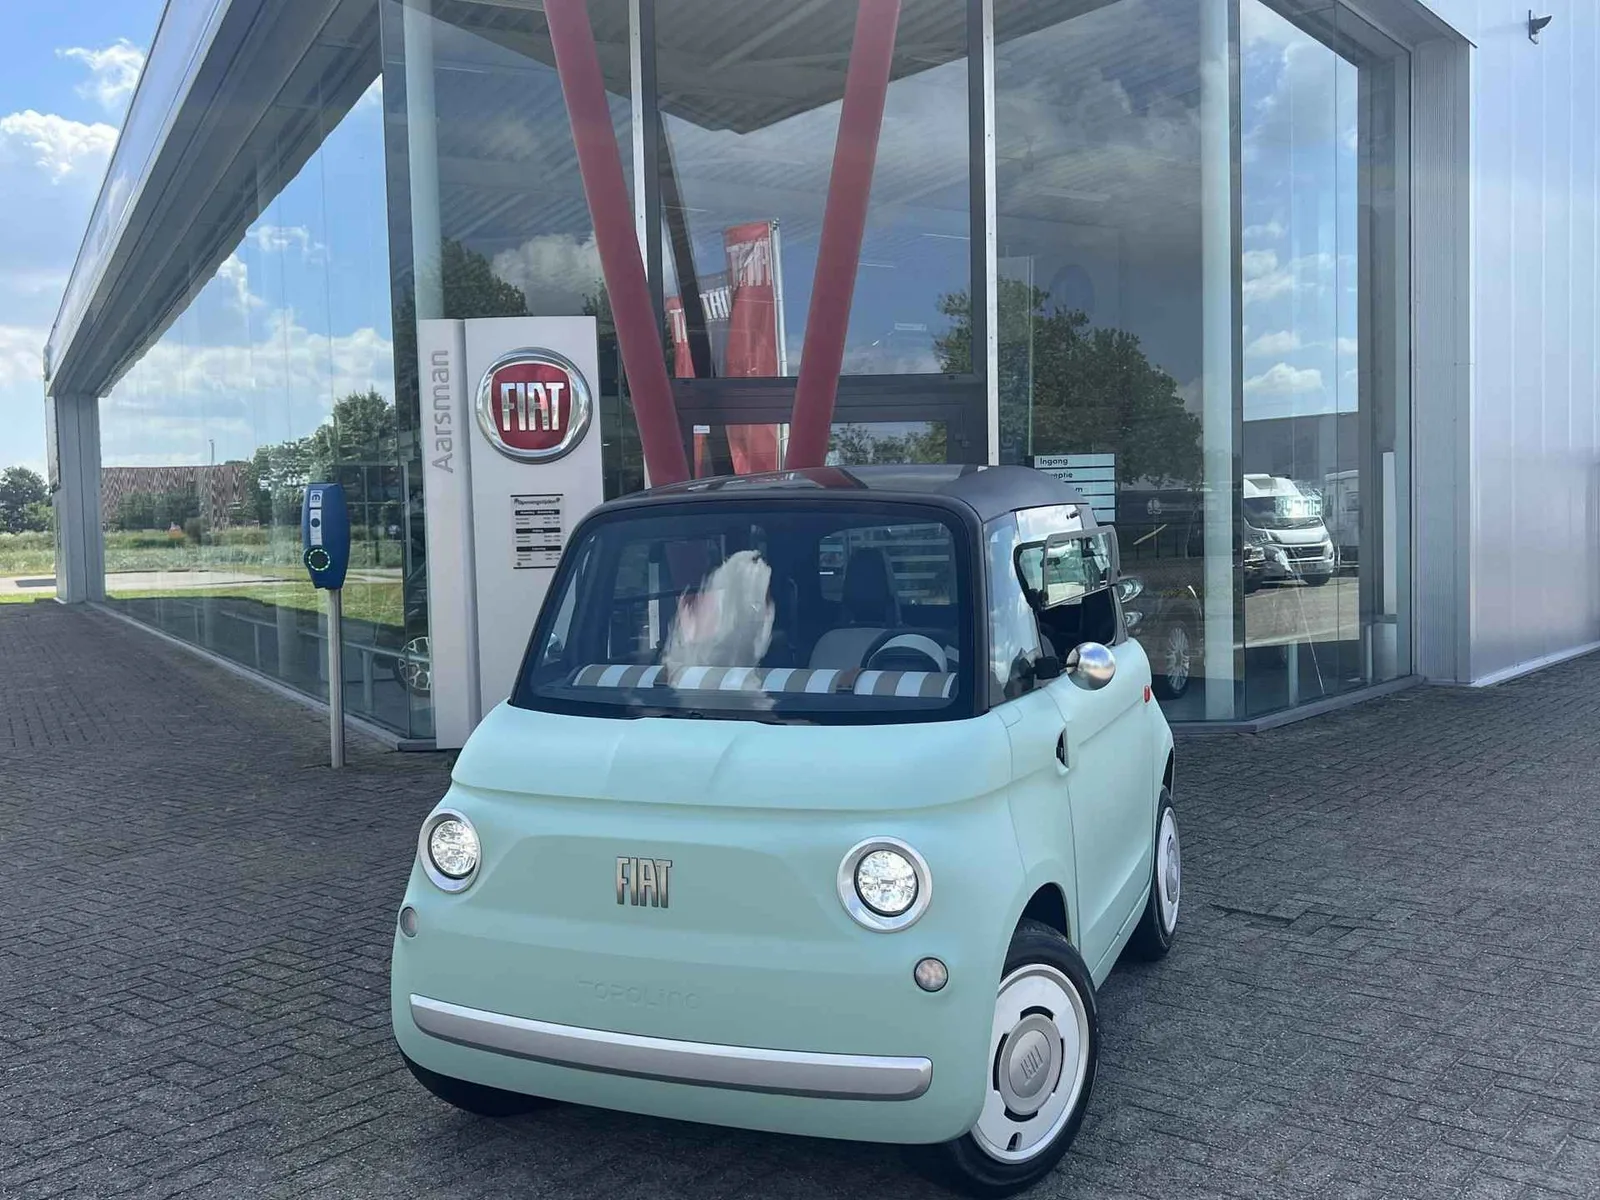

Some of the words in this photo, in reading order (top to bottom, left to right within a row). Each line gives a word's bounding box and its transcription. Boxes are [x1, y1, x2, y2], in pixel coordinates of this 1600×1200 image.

[431, 350, 454, 473] Aarsman
[500, 382, 565, 431] FIAT
[1040, 458, 1068, 466] Ingang
[616, 856, 673, 909] FIAT
